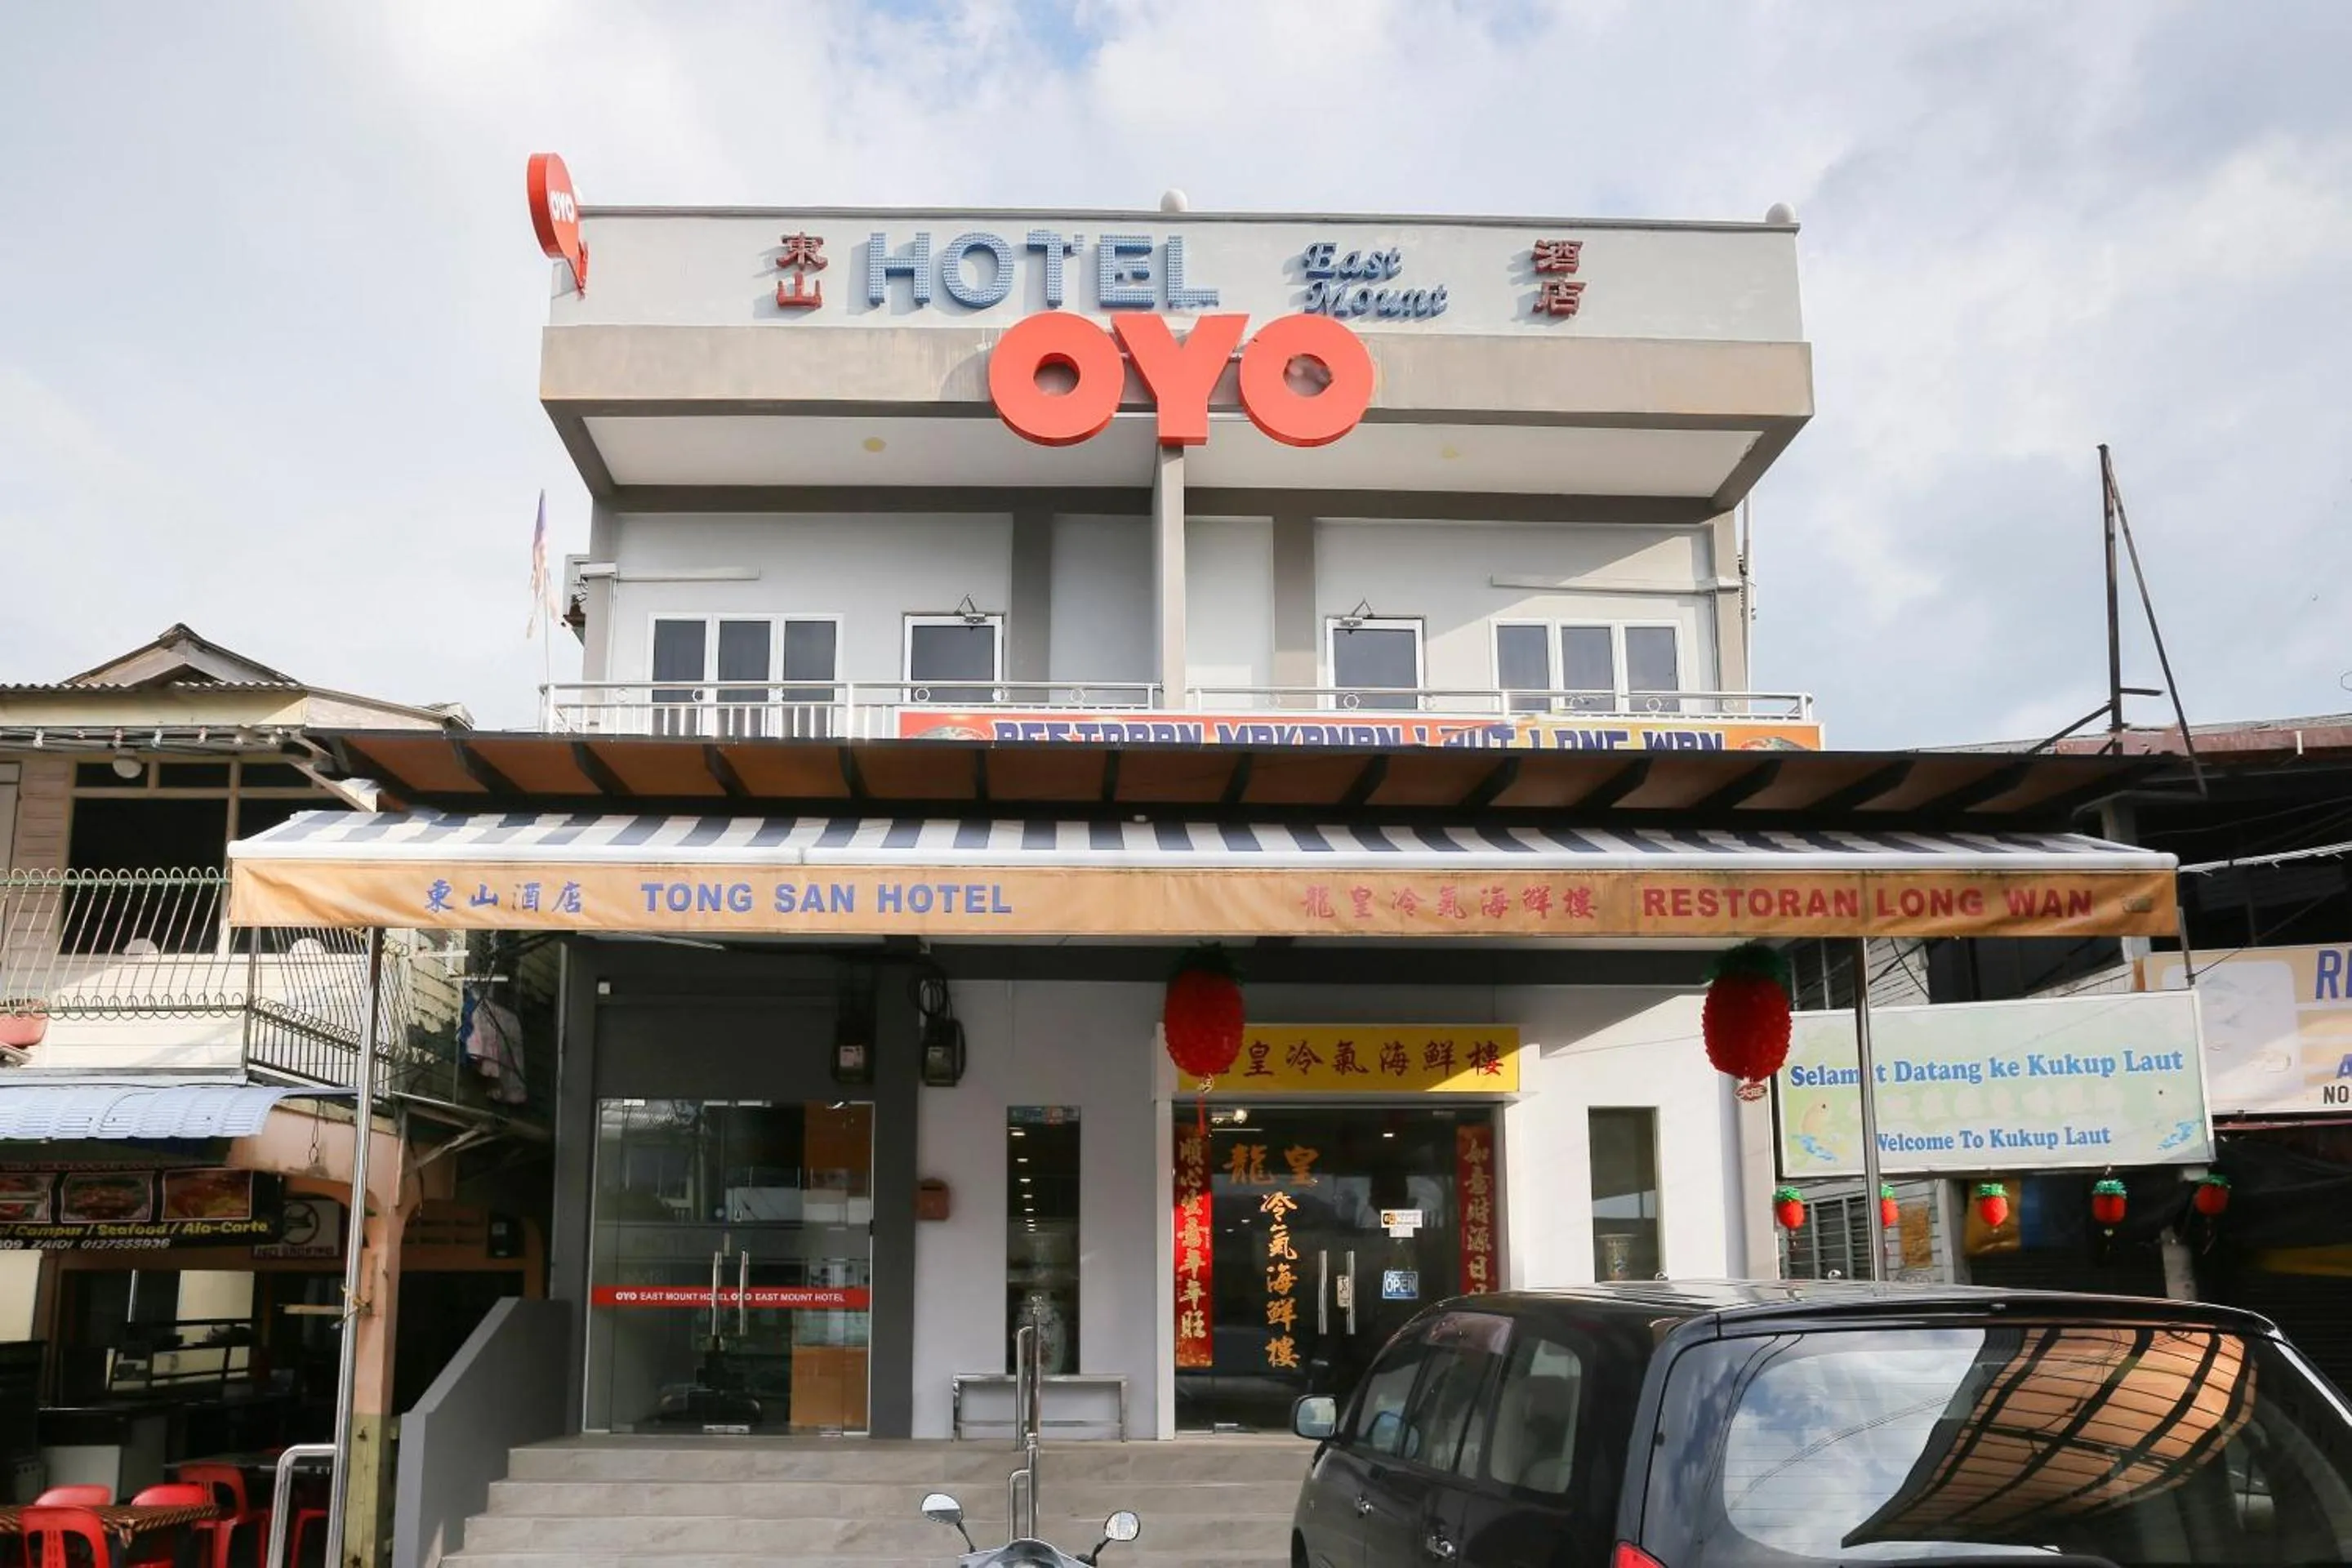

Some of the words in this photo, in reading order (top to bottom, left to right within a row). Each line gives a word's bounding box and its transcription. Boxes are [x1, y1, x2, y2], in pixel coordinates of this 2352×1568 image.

[550, 190, 574, 223] OYO
[776, 232, 828, 309] 東山
[867, 229, 1220, 309] HOTEL
[1305, 242, 1403, 281] East
[1532, 240, 1586, 317] 酒店
[1304, 280, 1449, 318] Mount
[988, 310, 1374, 447] OYO
[424, 879, 583, 914] 東山酒店
[641, 883, 753, 913] TONG
[774, 884, 855, 914] SAN
[877, 884, 1013, 915] HOTEL
[1644, 888, 1859, 918] RESTORAN
[1877, 888, 1983, 918] LONG
[2004, 889, 2093, 918] WAN
[2314, 948, 2352, 1000] R
[1222, 1040, 1505, 1076] 皇冷氣海鮮樓
[1791, 1065, 1886, 1086] Selamt
[1894, 1060, 1983, 1084] Datang
[1989, 1058, 2020, 1078] ke
[2027, 1053, 2116, 1078] Kukup
[2123, 1049, 2184, 1073] Laut
[1959, 1129, 1984, 1149] To
[1989, 1128, 2058, 1150] Kukup
[2063, 1126, 2111, 1145] Laut
[1223, 1143, 1318, 1185] 龍皇
[98, 1223, 167, 1236] Seafood
[616, 1292, 637, 1301] OYO
[640, 1292, 664, 1301] EAST
[666, 1293, 697, 1301] MOUNT
[700, 1293, 729, 1301] HOEL
[731, 1293, 751, 1301] OO
[815, 1294, 845, 1302] HOTEL
[1261, 1191, 1302, 1369] 冷氣海鮮樓
[1385, 1278, 1418, 1294] OPEN
